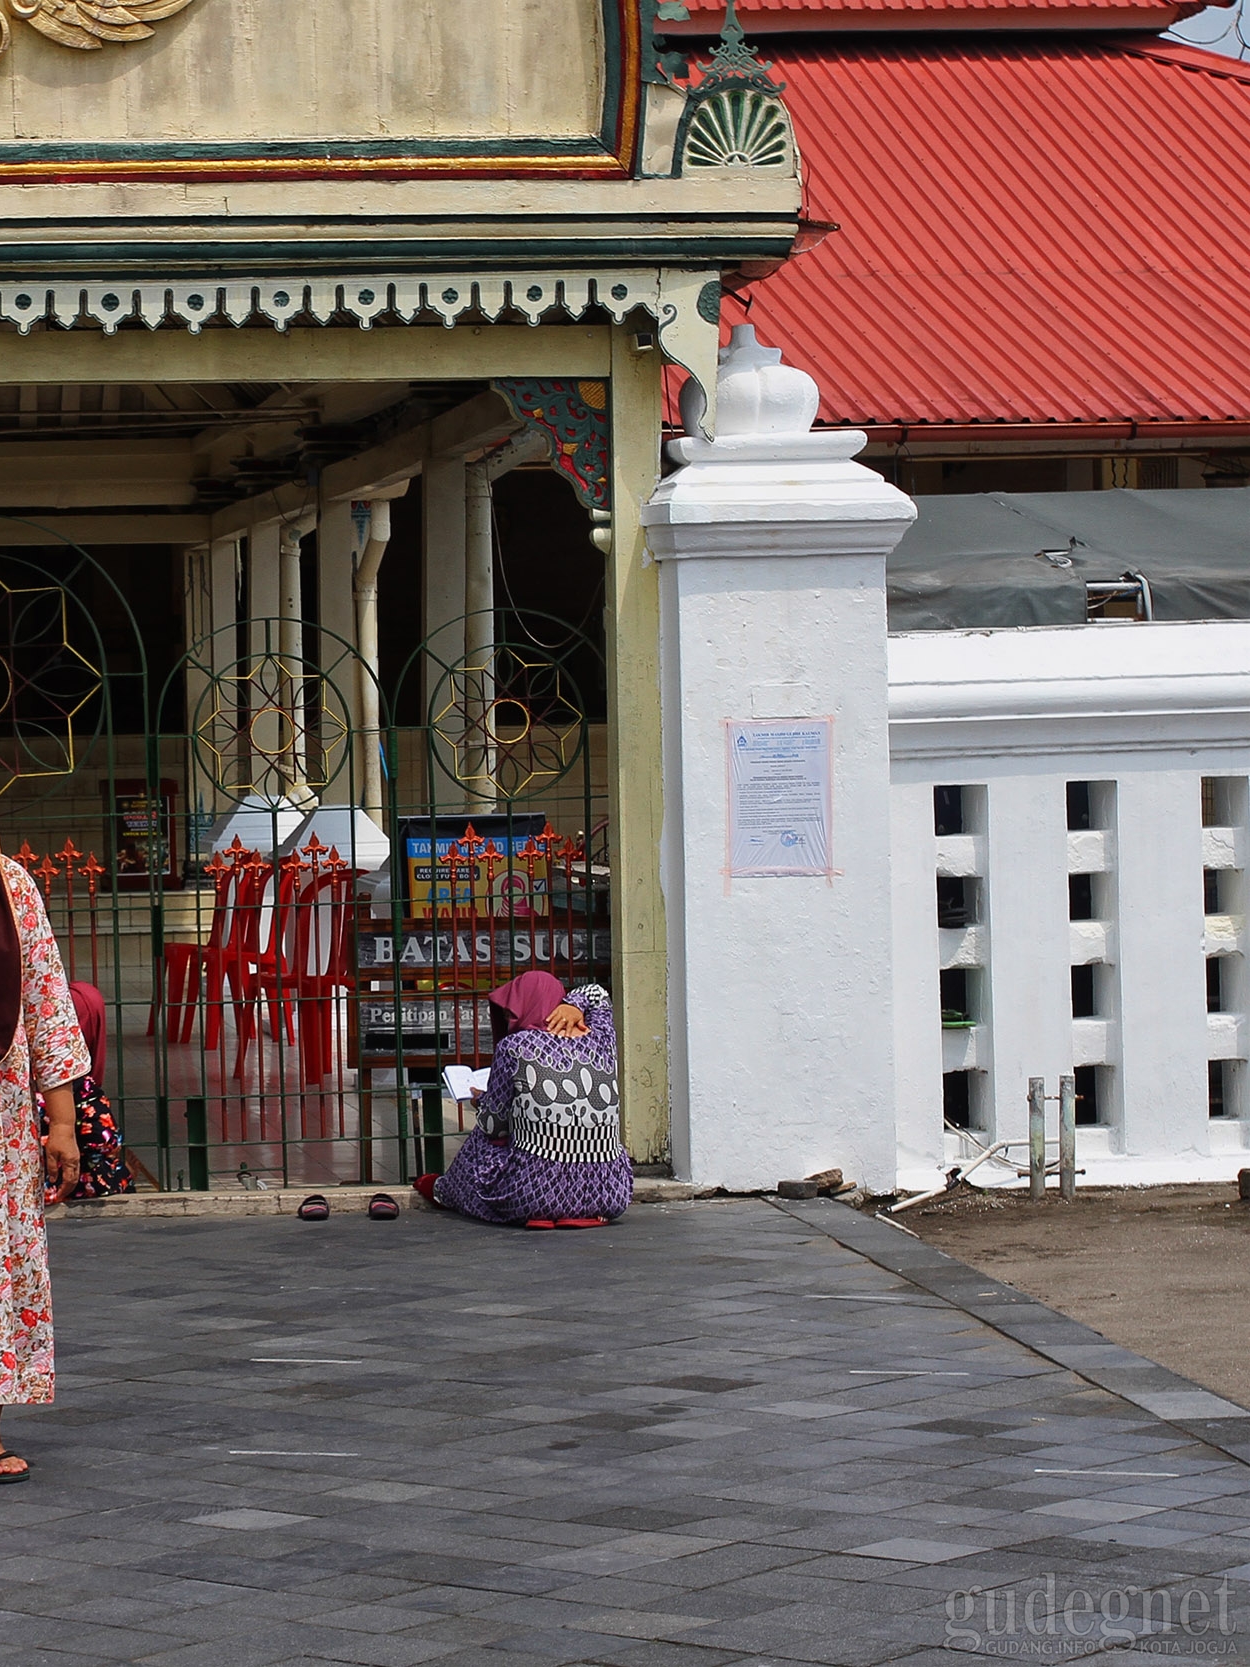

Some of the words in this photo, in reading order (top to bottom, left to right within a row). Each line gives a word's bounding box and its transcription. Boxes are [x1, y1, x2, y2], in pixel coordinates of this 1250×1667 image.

[412, 842, 453, 854] TAKMI
[373, 936, 492, 964] BATAS
[513, 933, 598, 962] SUCI
